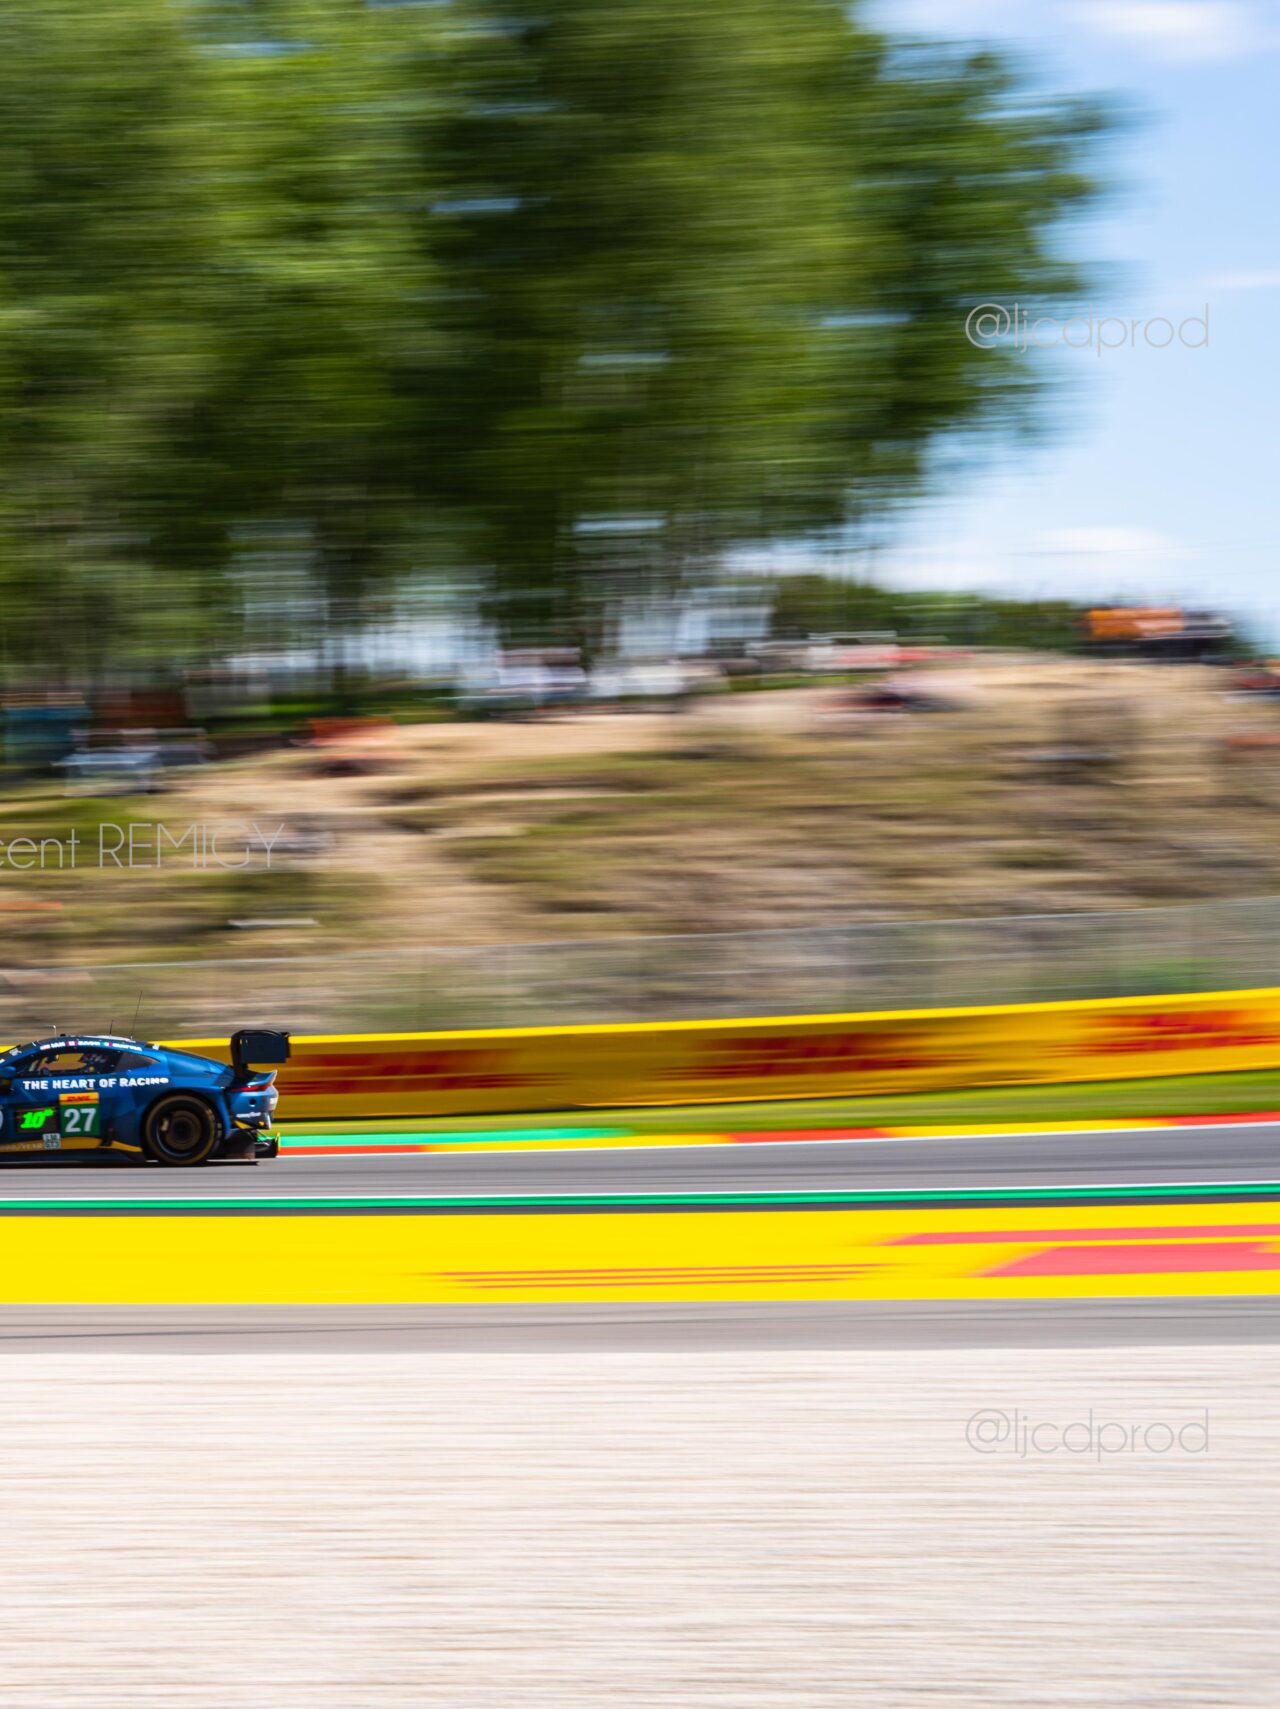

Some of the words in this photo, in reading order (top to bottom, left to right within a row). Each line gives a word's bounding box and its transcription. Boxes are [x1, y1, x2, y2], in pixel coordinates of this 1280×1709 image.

[23, 1080, 48, 1090] THE
[52, 1079, 95, 1089] HEART
[99, 1078, 116, 1088] OF
[119, 1077, 169, 1088] RACING
[63, 1107, 97, 1133] 27
